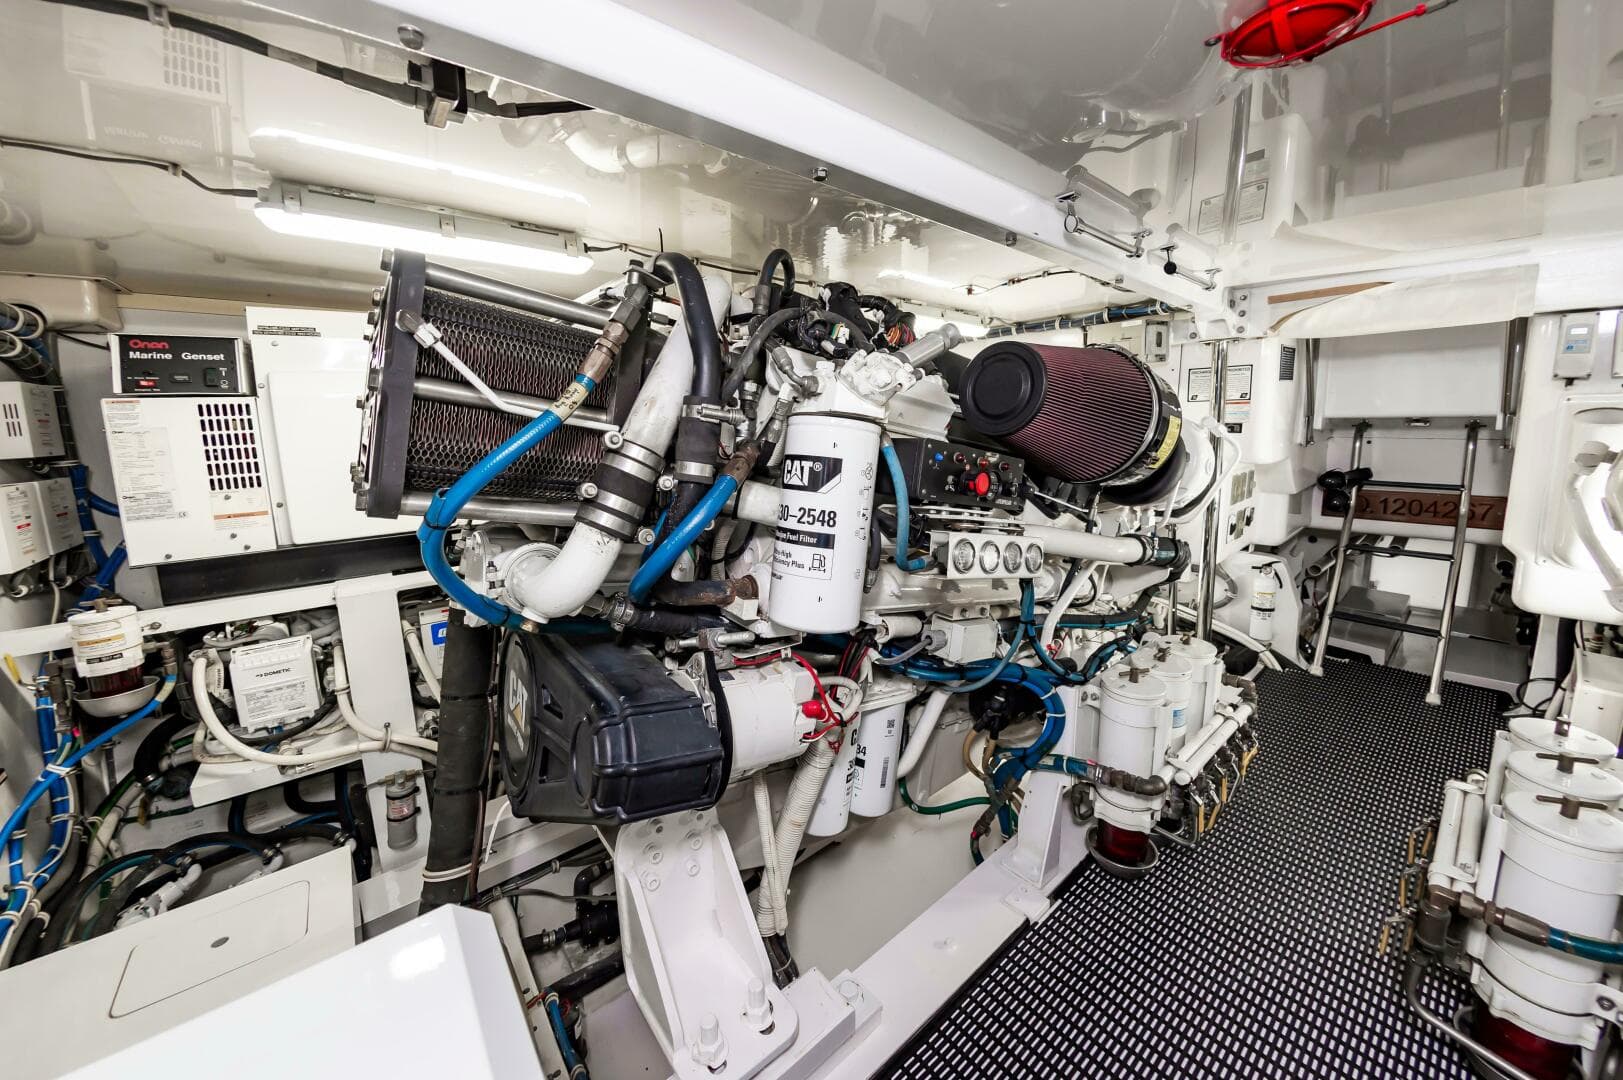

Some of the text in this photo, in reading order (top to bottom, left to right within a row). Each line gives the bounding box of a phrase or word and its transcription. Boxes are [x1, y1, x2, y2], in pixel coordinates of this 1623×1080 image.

[129, 339, 169, 349] Onan
[129, 351, 225, 360] Marine Genset
[787, 532, 799, 541] Fuel
[799, 534, 818, 544] Filter
[791, 560, 805, 569] Plus
[509, 669, 528, 733] CAT
